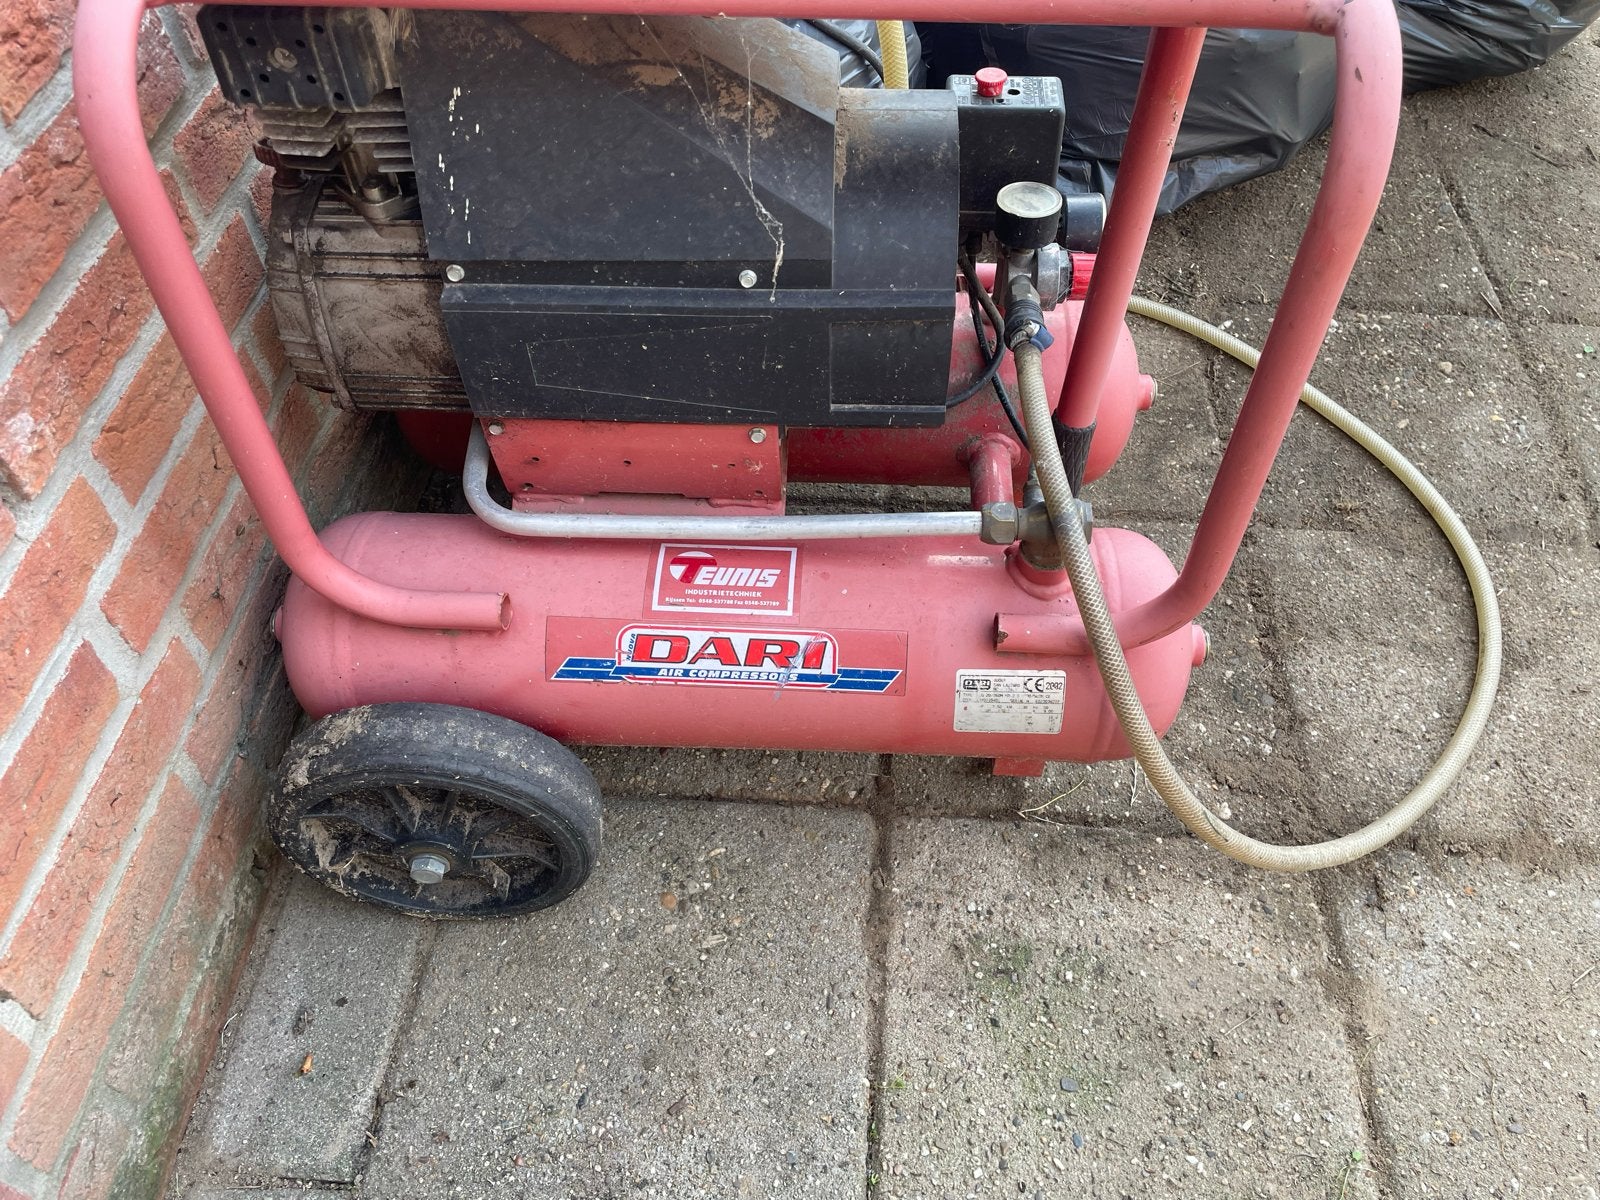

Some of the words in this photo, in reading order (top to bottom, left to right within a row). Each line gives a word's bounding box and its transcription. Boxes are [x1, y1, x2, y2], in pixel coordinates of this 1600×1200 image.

[670, 556, 781, 588] TEUNIS
[685, 589, 763, 598] INDUSTRIETECHNIEK
[626, 633, 636, 661] NUOVA
[631, 633, 828, 670] DARI
[658, 668, 683, 677] AIR
[688, 670, 799, 681] COMPRESSORS
